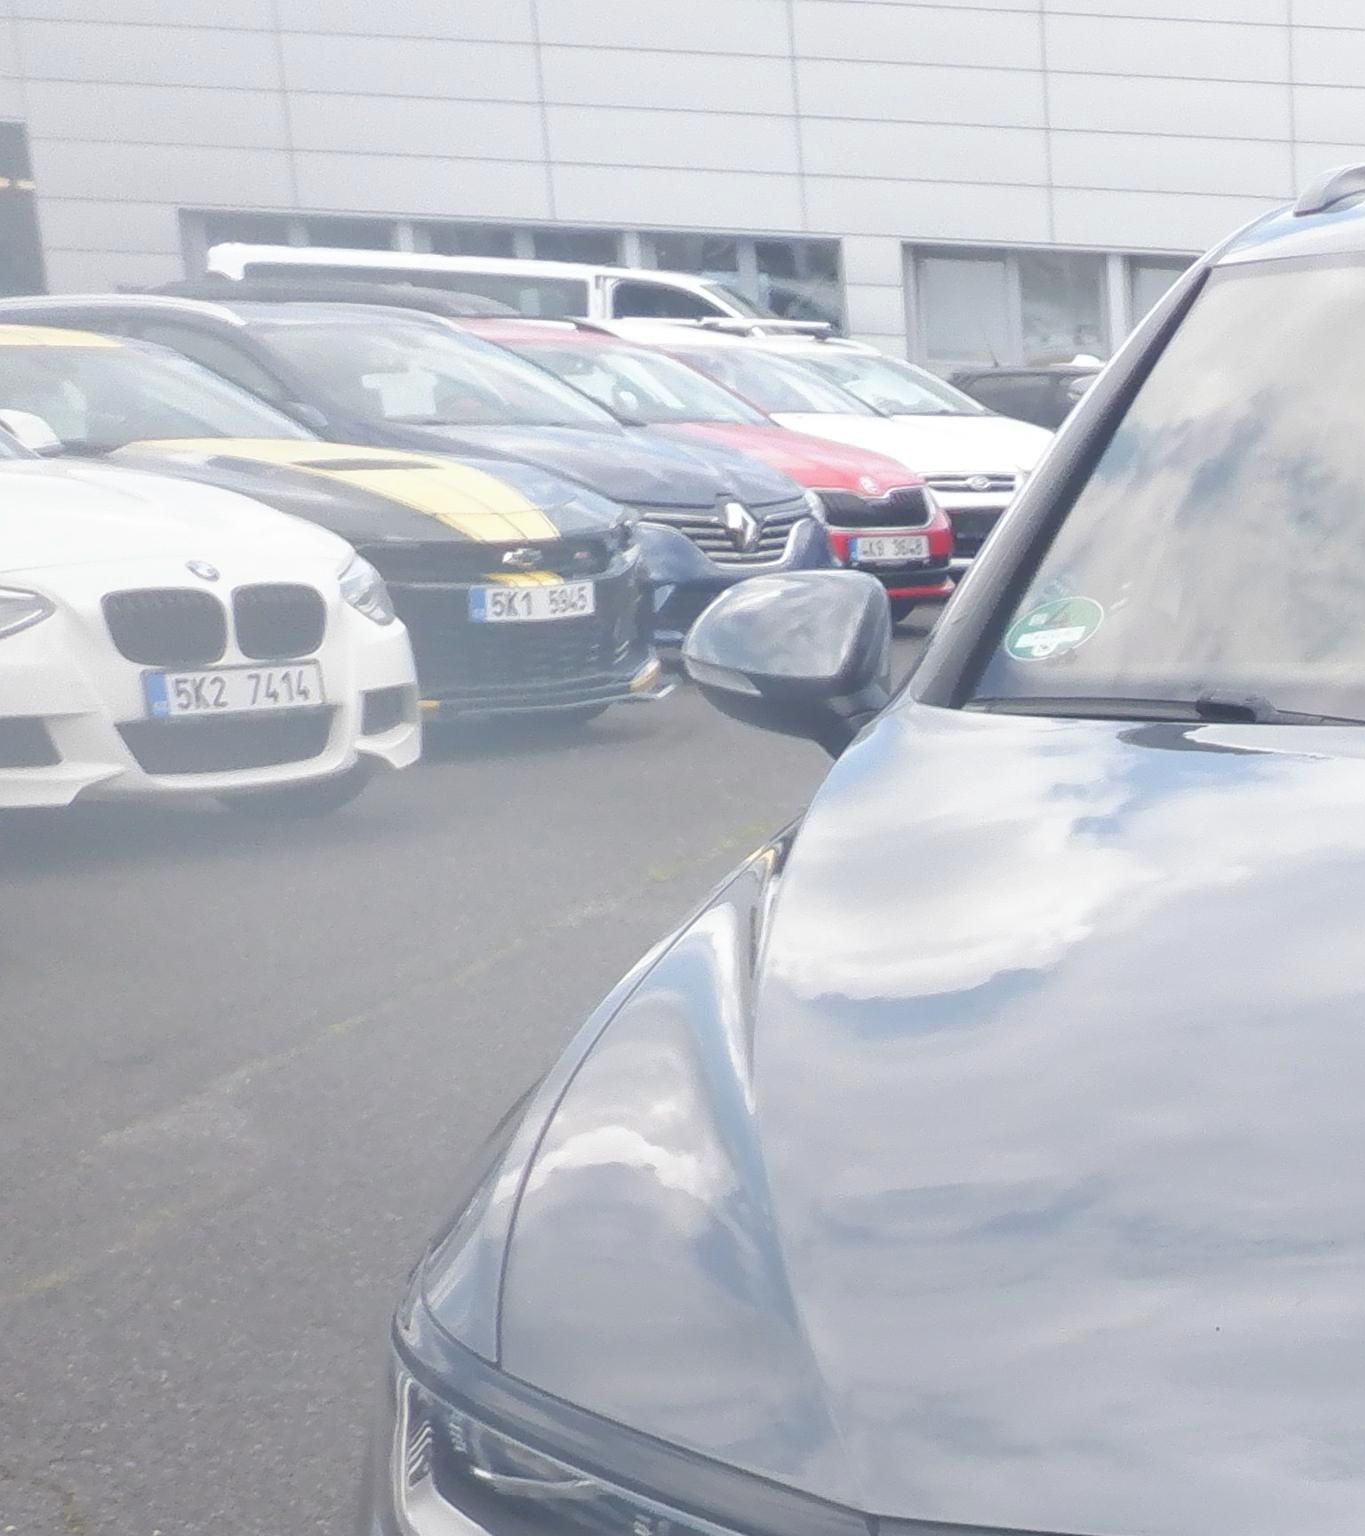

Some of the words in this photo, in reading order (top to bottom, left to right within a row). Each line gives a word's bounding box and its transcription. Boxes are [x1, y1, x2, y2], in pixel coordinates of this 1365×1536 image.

[491, 590, 533, 617] 5K1
[174, 675, 229, 710] 5K2
[247, 669, 311, 705] 7414
